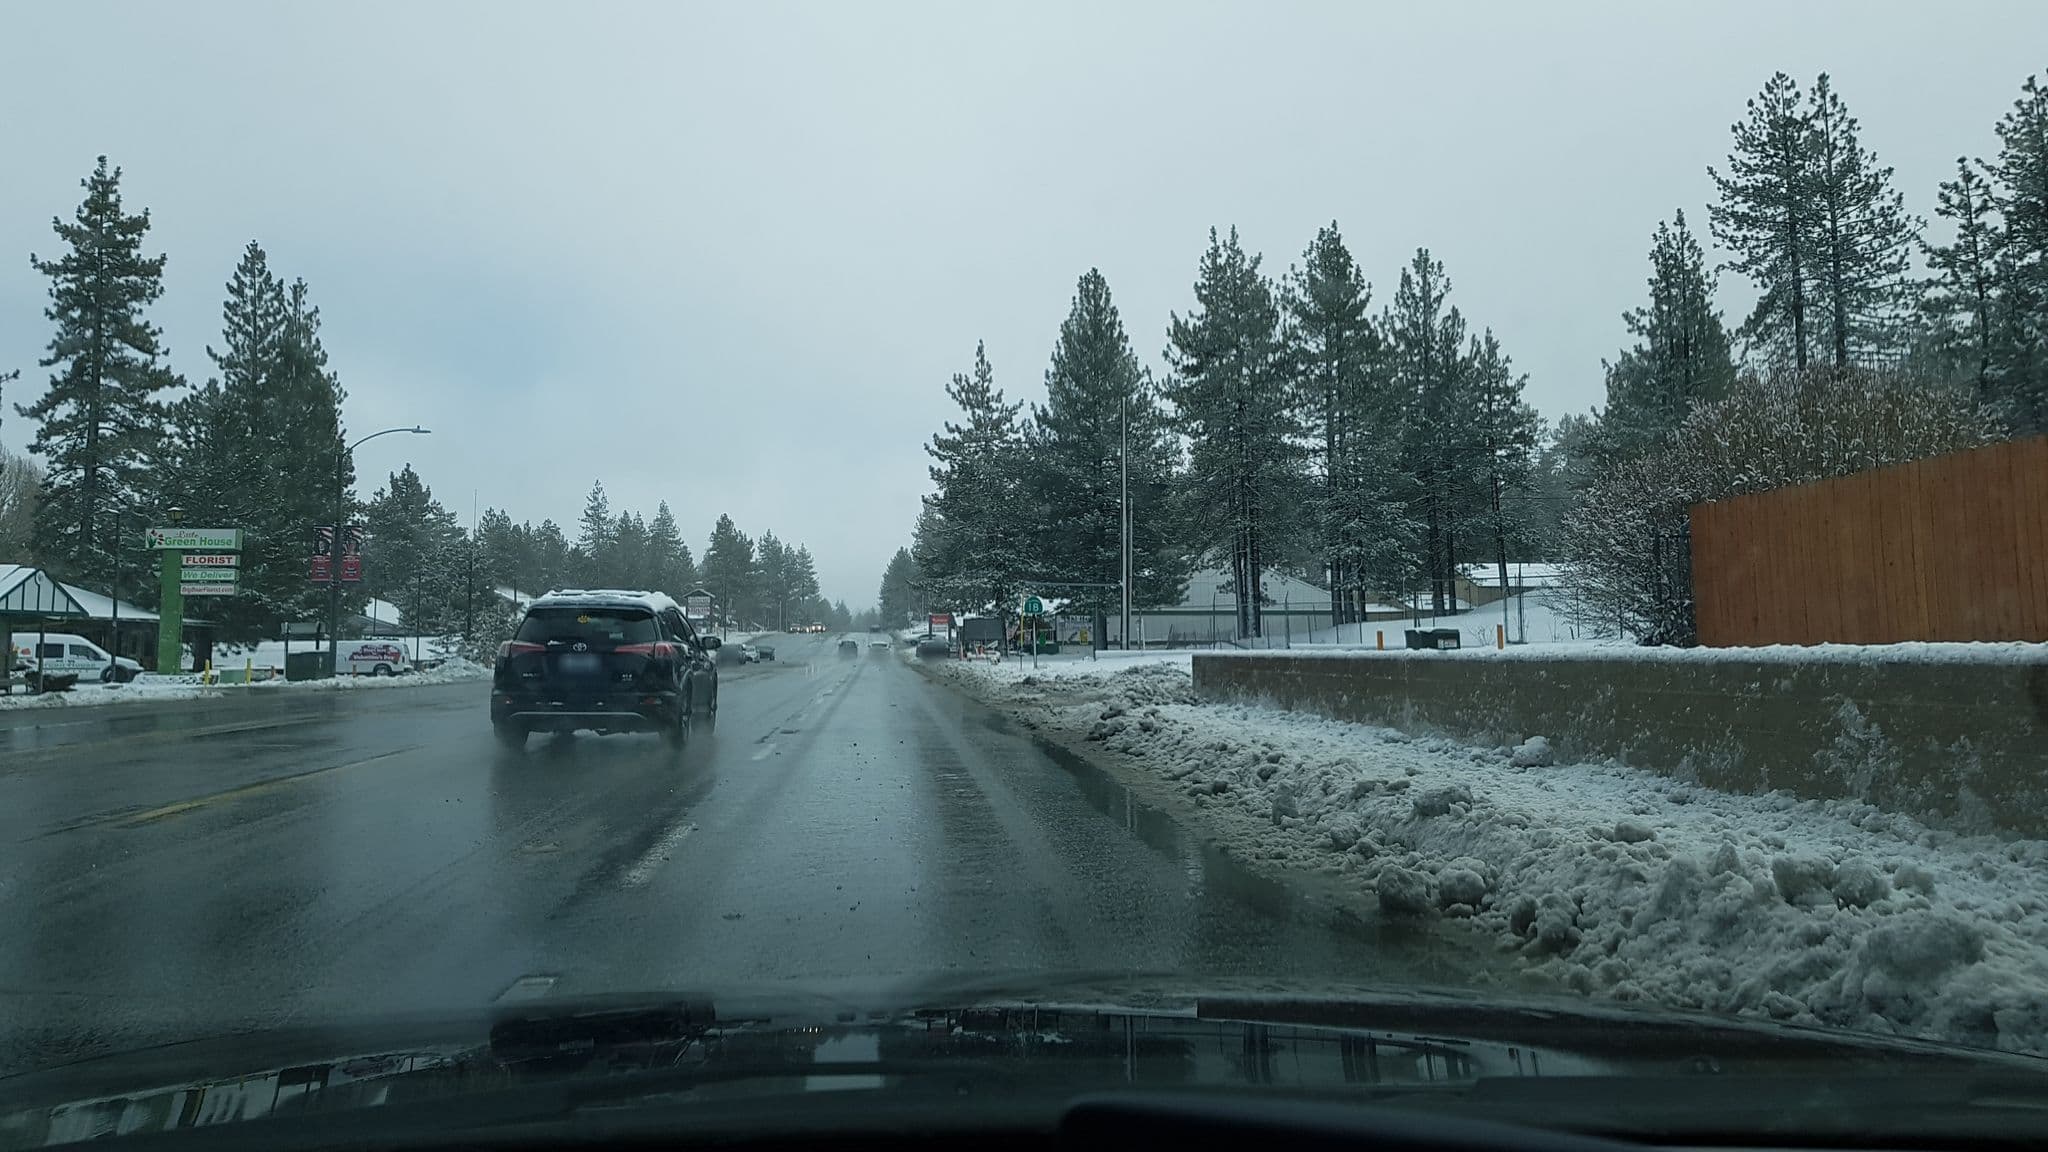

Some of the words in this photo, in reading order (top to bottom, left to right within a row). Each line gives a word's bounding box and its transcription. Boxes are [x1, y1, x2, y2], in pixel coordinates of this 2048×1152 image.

[165, 536, 196, 546] Green
[200, 536, 232, 546] House
[186, 556, 232, 564] FLORIST
[183, 571, 198, 579] We
[200, 571, 233, 579] Deliver
[1028, 603, 1039, 612] 18
